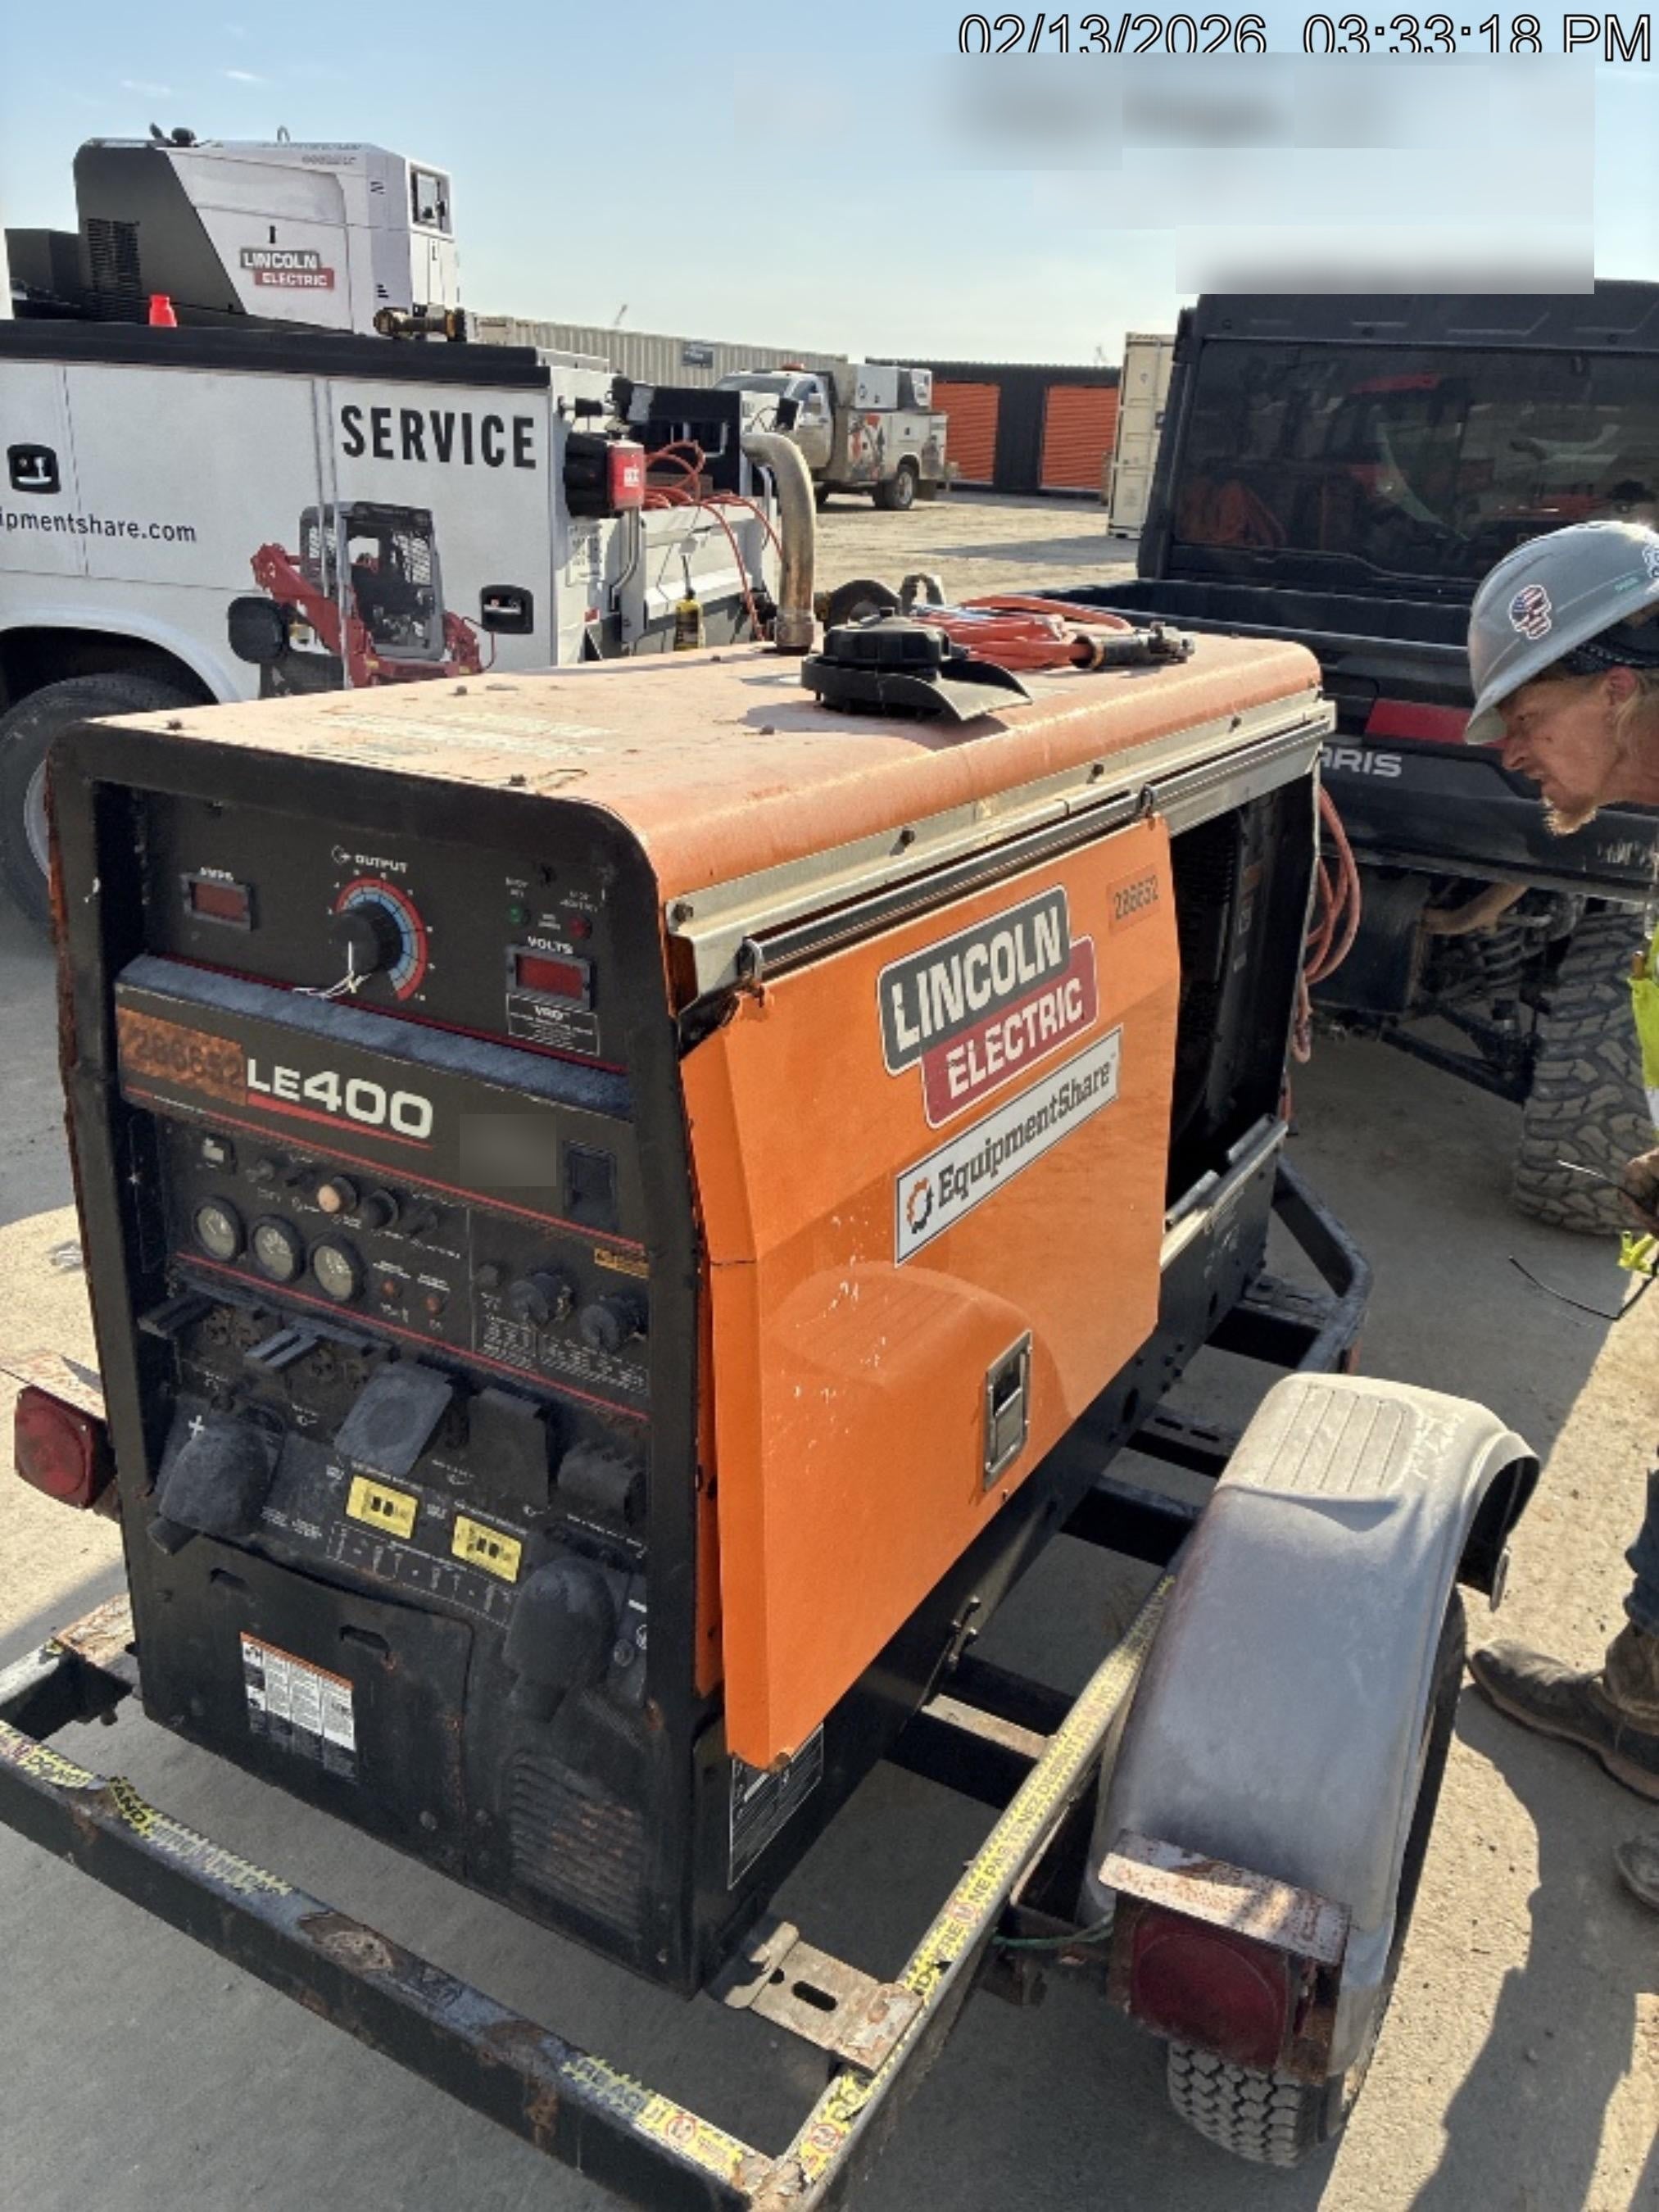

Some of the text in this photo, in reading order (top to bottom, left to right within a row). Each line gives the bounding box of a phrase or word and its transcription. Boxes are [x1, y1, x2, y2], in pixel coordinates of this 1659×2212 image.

[243, 252, 318, 270] LINCOLN
[261, 272, 329, 286] ELECTRIC
[341, 405, 536, 469] SERVICE
[528, 936, 573, 954] VOLTS
[891, 906, 1063, 1052] LINCOLN
[945, 978, 1083, 1099] ELECTRIC
[247, 1058, 434, 1139] LE400
[939, 1061, 1111, 1208] EquipmentShare
